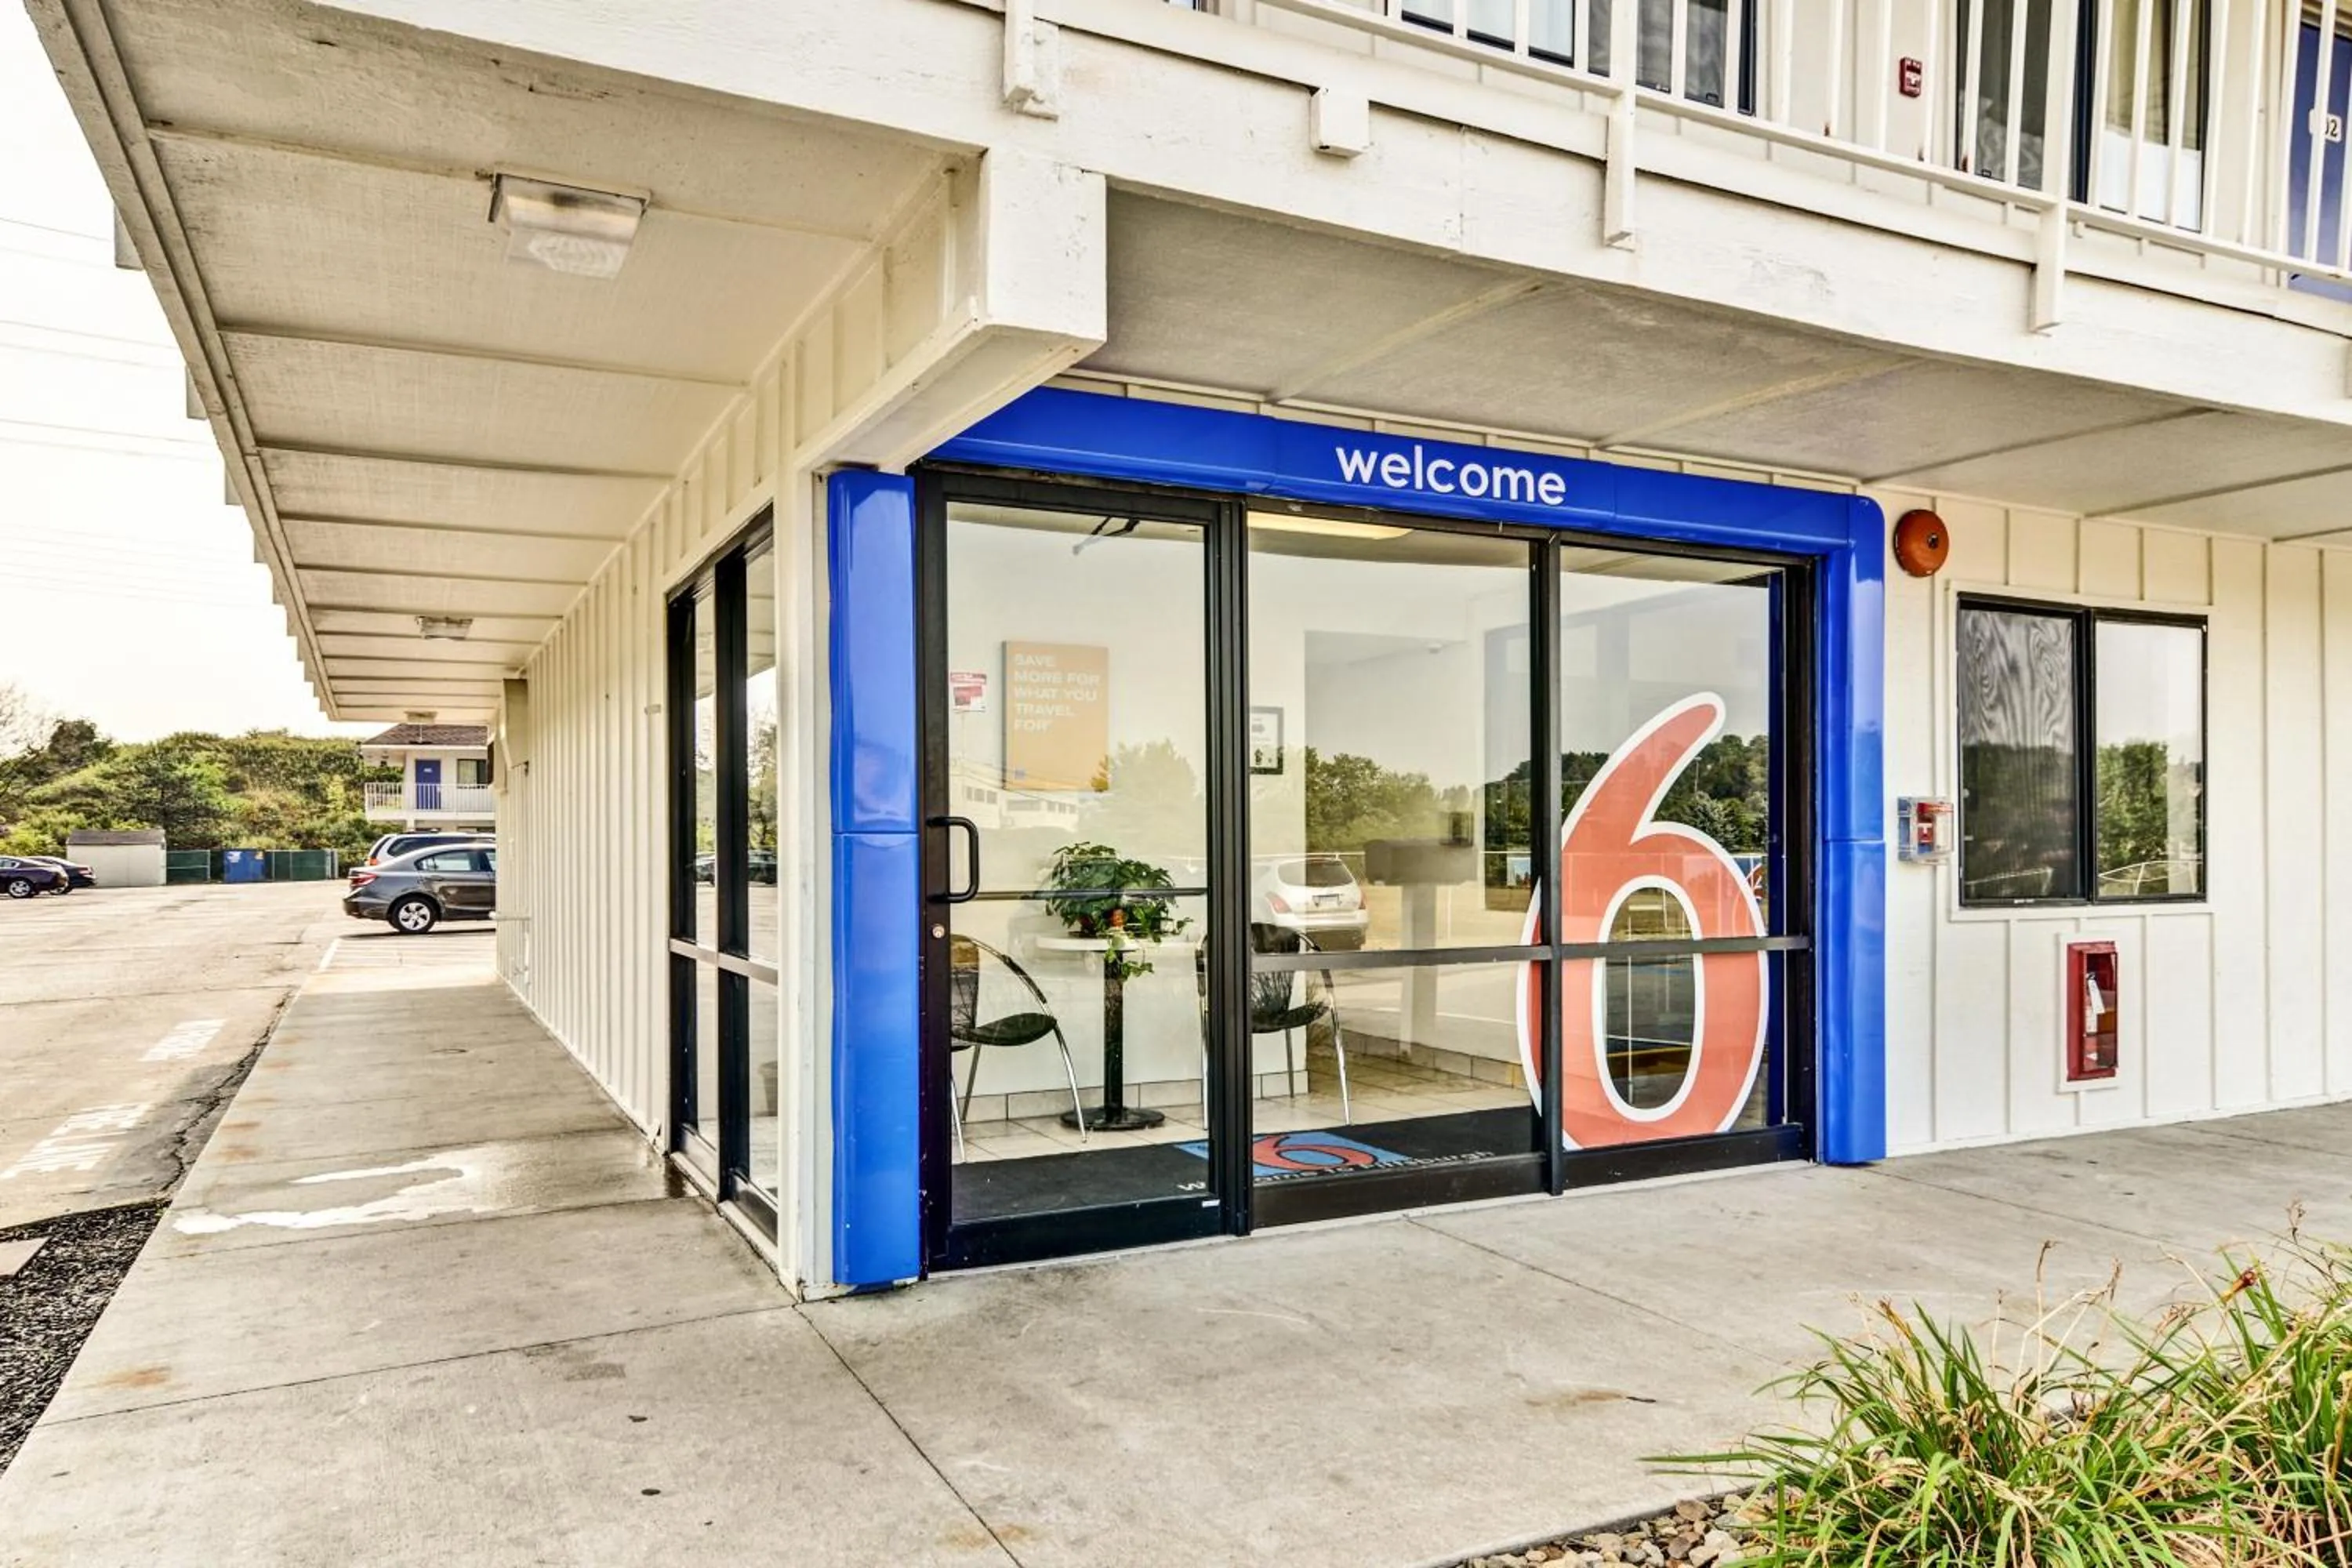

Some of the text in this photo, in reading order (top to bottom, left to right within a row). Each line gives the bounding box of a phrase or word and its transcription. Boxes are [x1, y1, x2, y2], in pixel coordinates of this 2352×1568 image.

[1335, 445, 1566, 506] welcome
[1015, 653, 1055, 667] SAVE
[1014, 670, 1100, 686] MORE FOR
[1014, 687, 1098, 702] WHAT YOU
[1015, 703, 1075, 717] TRAVEL
[1516, 691, 1769, 1150] 6
